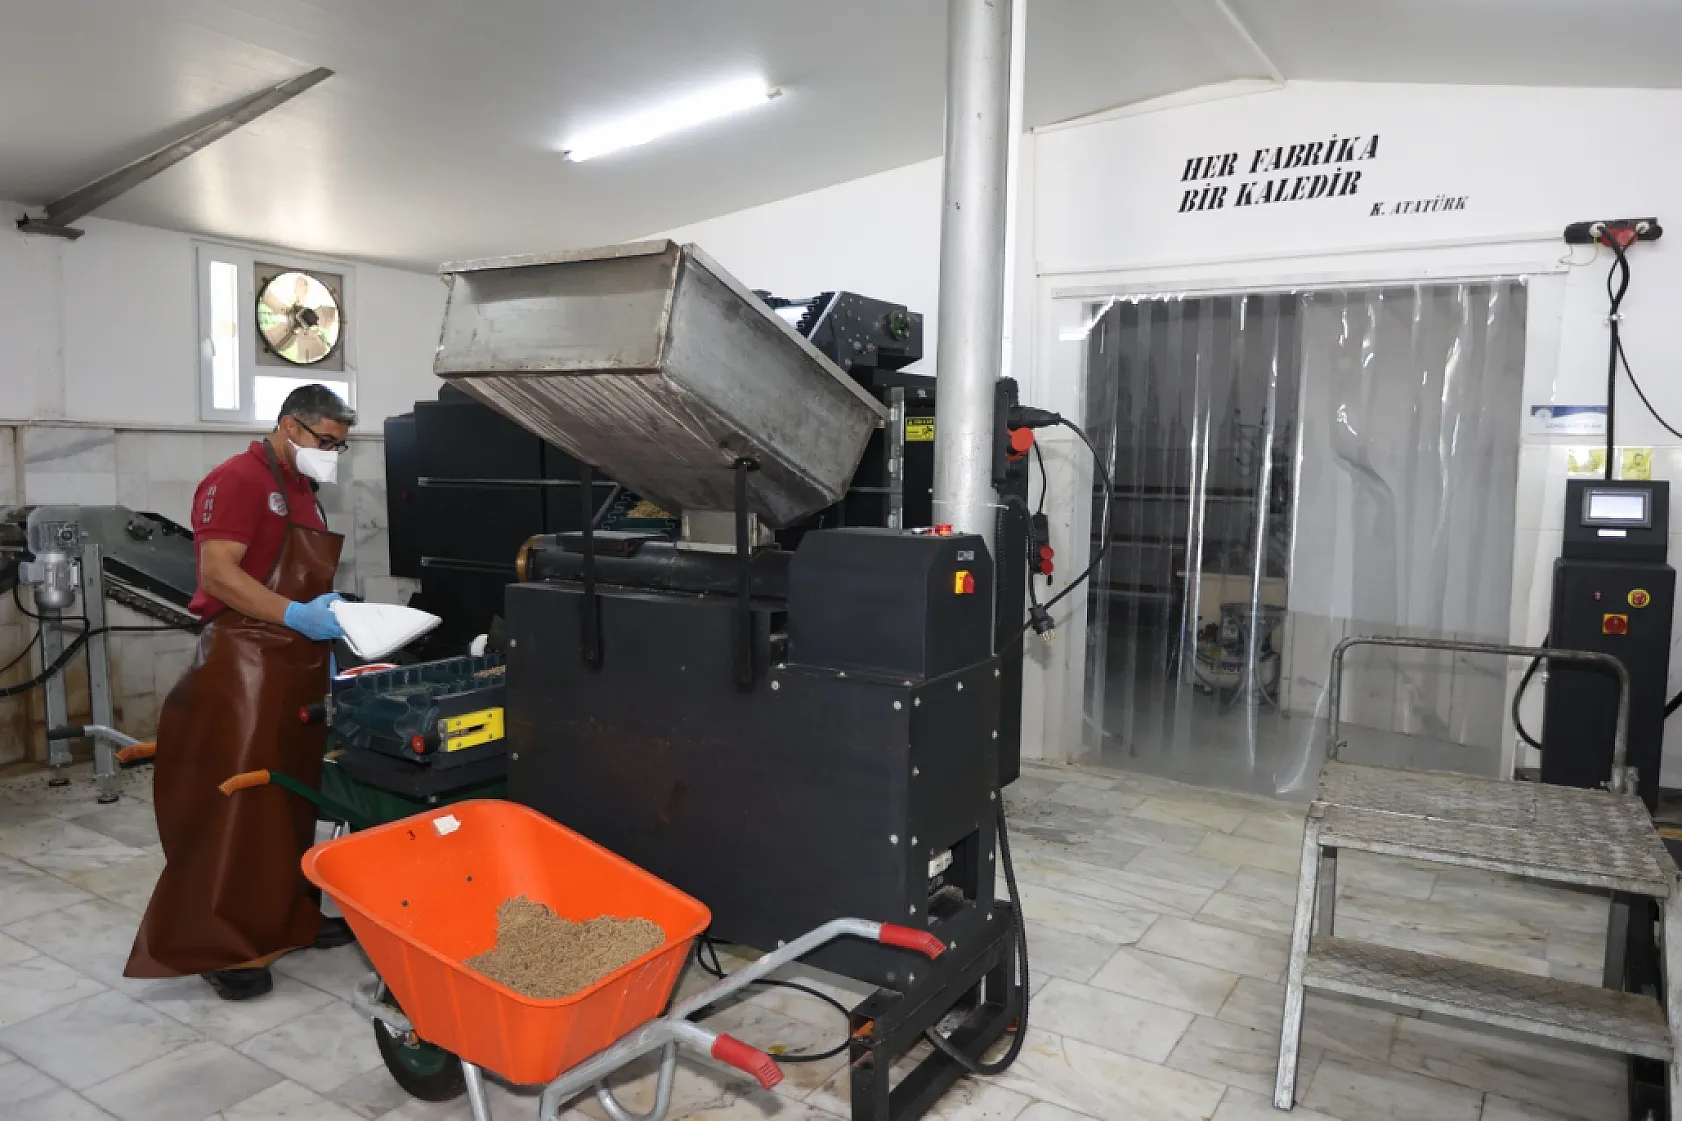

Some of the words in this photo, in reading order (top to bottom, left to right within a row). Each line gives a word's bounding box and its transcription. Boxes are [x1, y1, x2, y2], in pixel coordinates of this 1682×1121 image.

[1180, 152, 1238, 182] HER
[1249, 134, 1379, 174] FABRİKA
[1178, 183, 1229, 214] BİR
[1233, 167, 1362, 207] KALEDİR
[1369, 202, 1386, 217] K.
[1389, 194, 1469, 215] ATATÜRK
